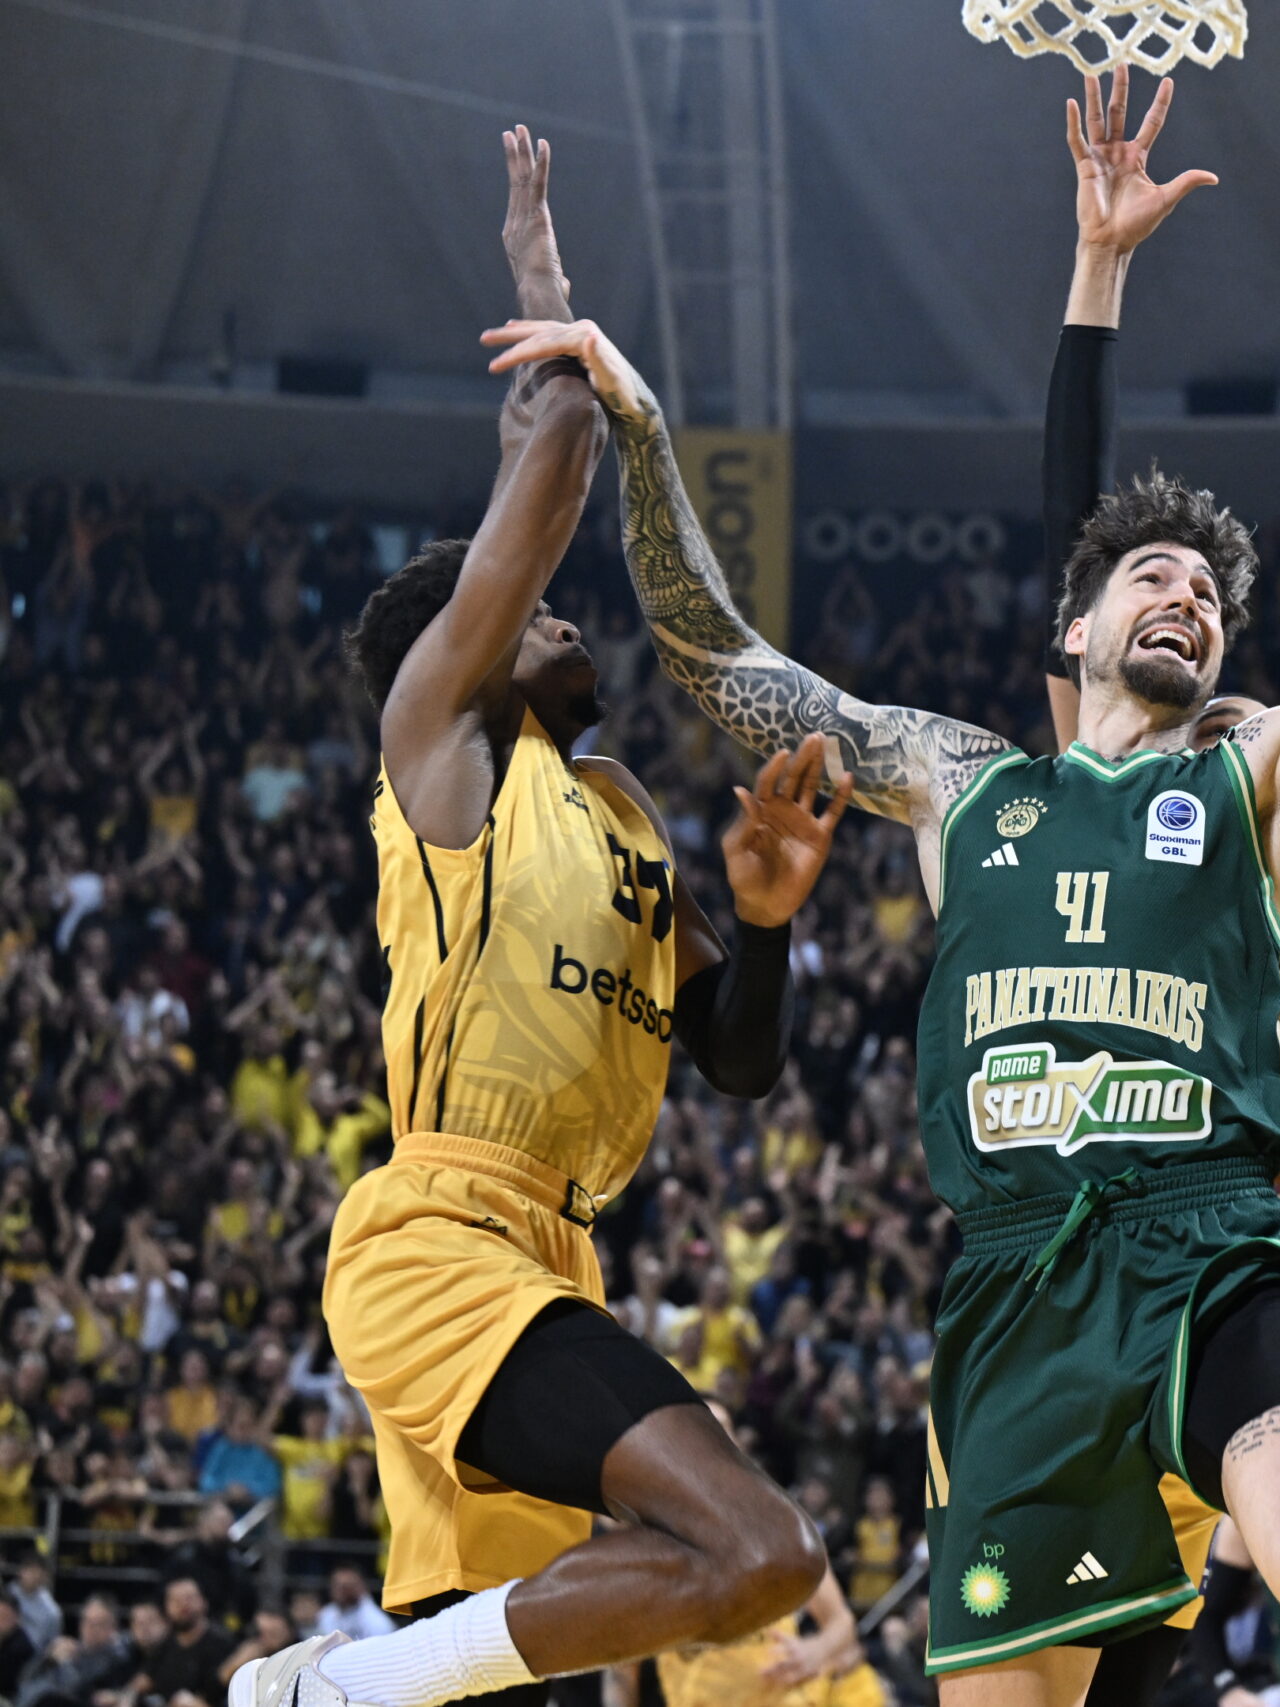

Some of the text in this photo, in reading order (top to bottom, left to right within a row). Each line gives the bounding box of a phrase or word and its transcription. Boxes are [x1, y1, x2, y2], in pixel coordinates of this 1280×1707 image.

[1149, 833, 1201, 846] Stoiximan
[1162, 846, 1187, 857] GBL
[1055, 871, 1110, 944] 41
[964, 966, 1208, 1053] PANATHINAIKOS
[990, 1055, 1041, 1081] pame
[983, 1542, 1005, 1559] bp
